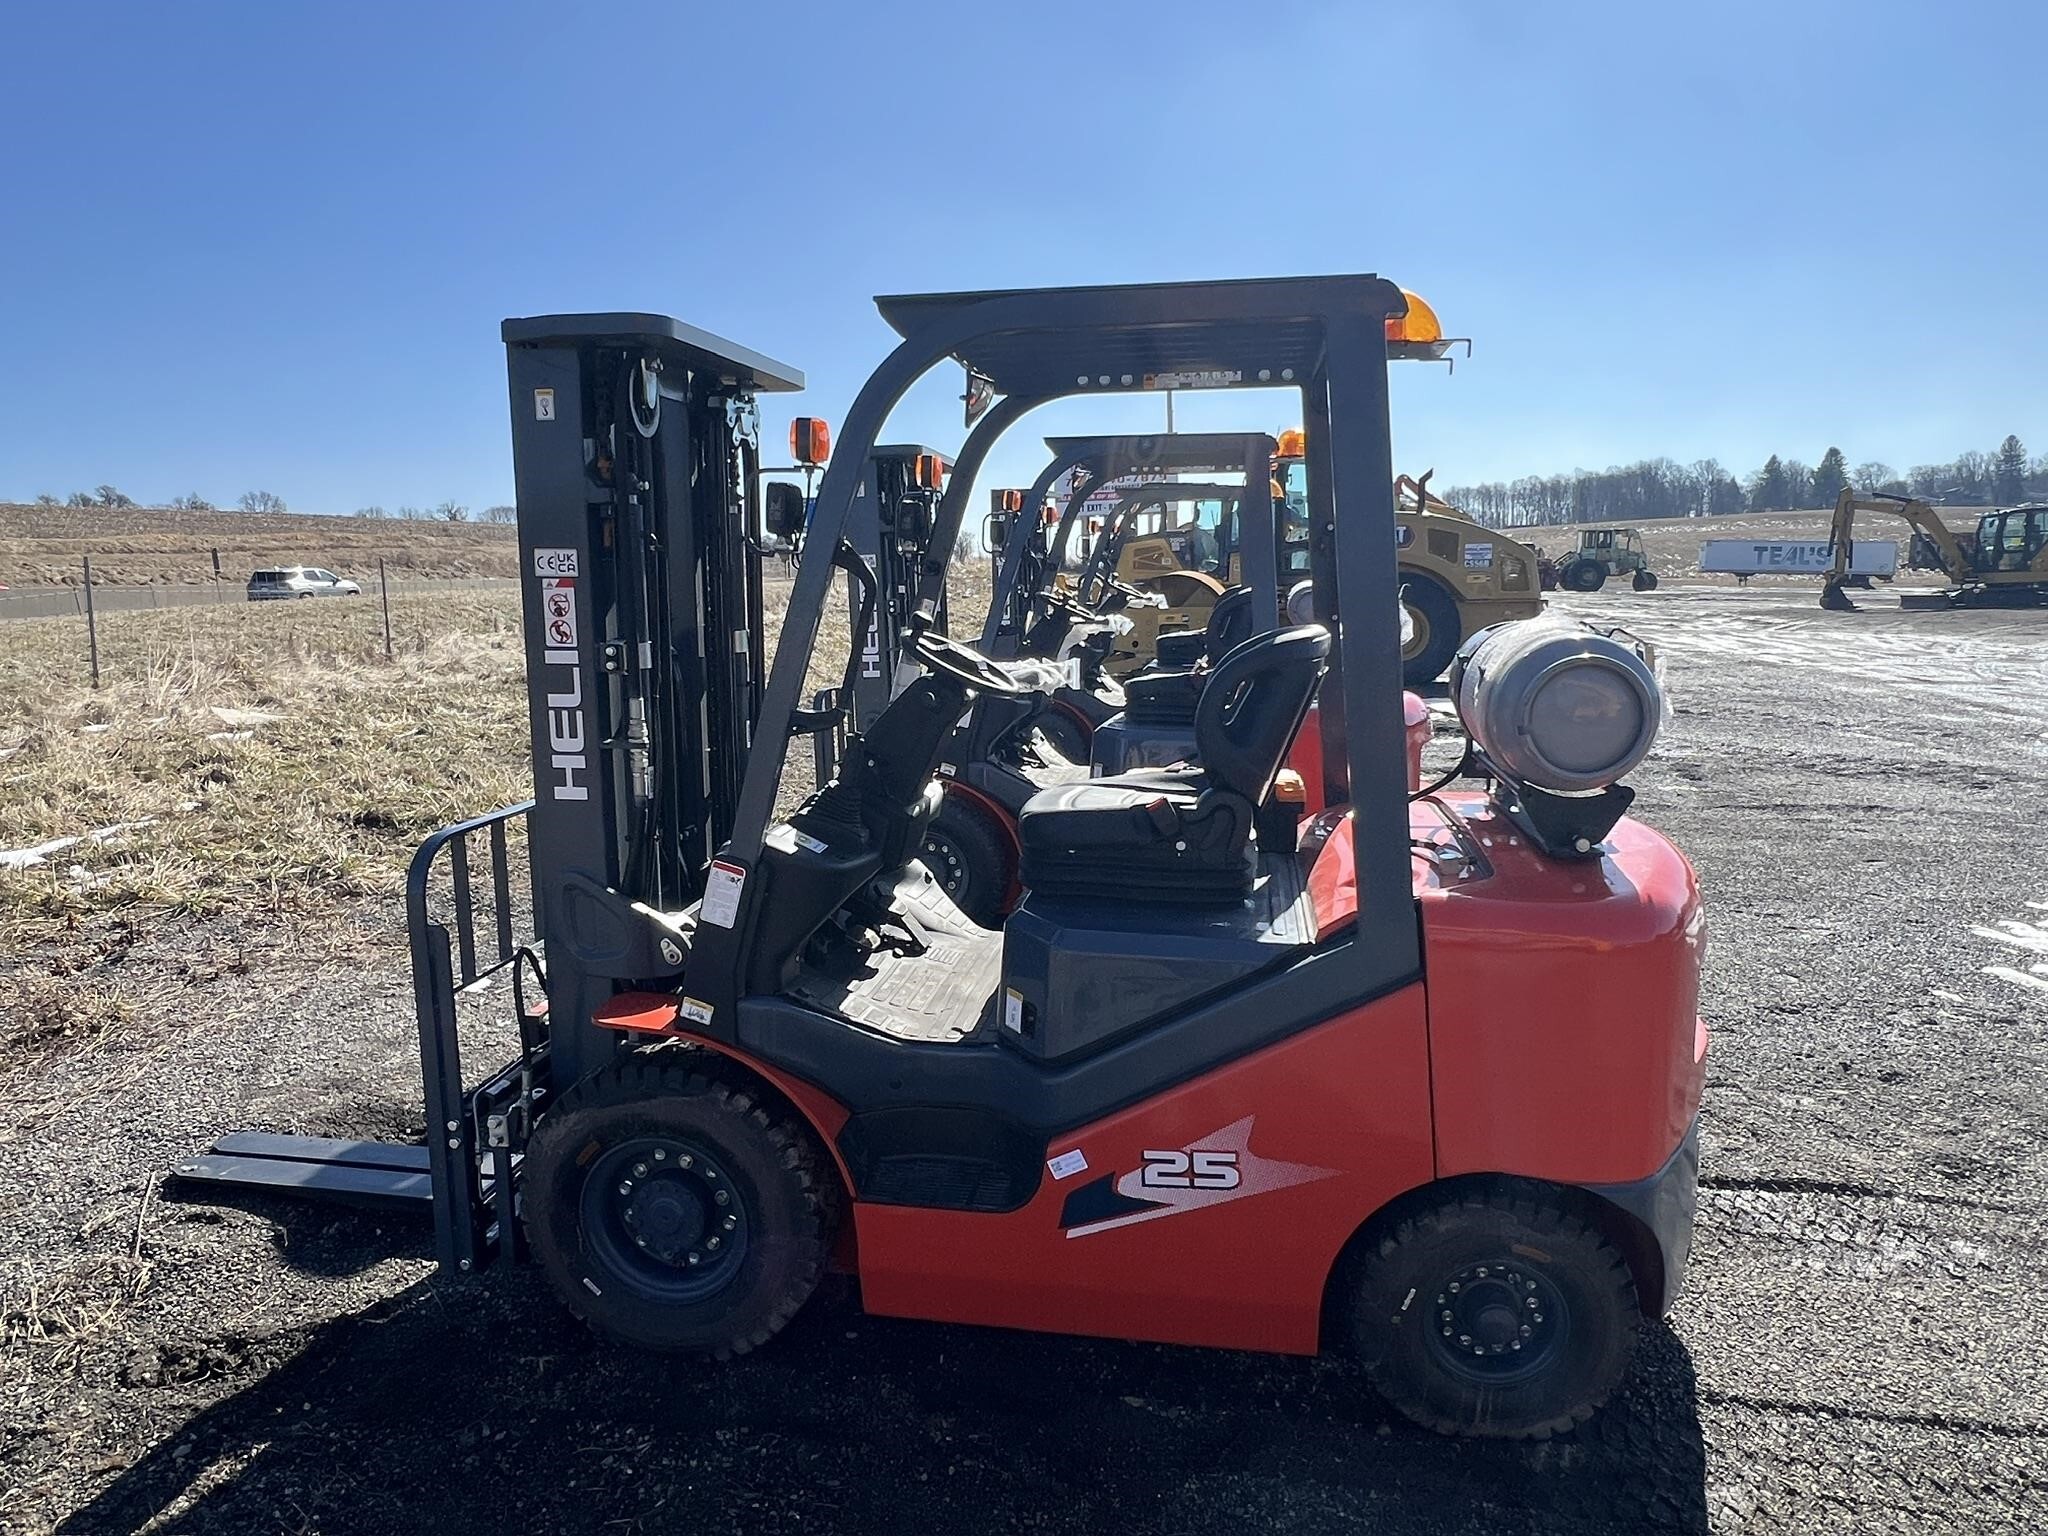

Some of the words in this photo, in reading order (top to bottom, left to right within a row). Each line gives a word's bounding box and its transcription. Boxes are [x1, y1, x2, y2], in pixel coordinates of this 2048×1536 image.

[557, 554, 574, 562] UK
[1753, 546, 1831, 566] TEAL'S
[544, 650, 588, 800] HELI
[1142, 1150, 1240, 1189] 25
